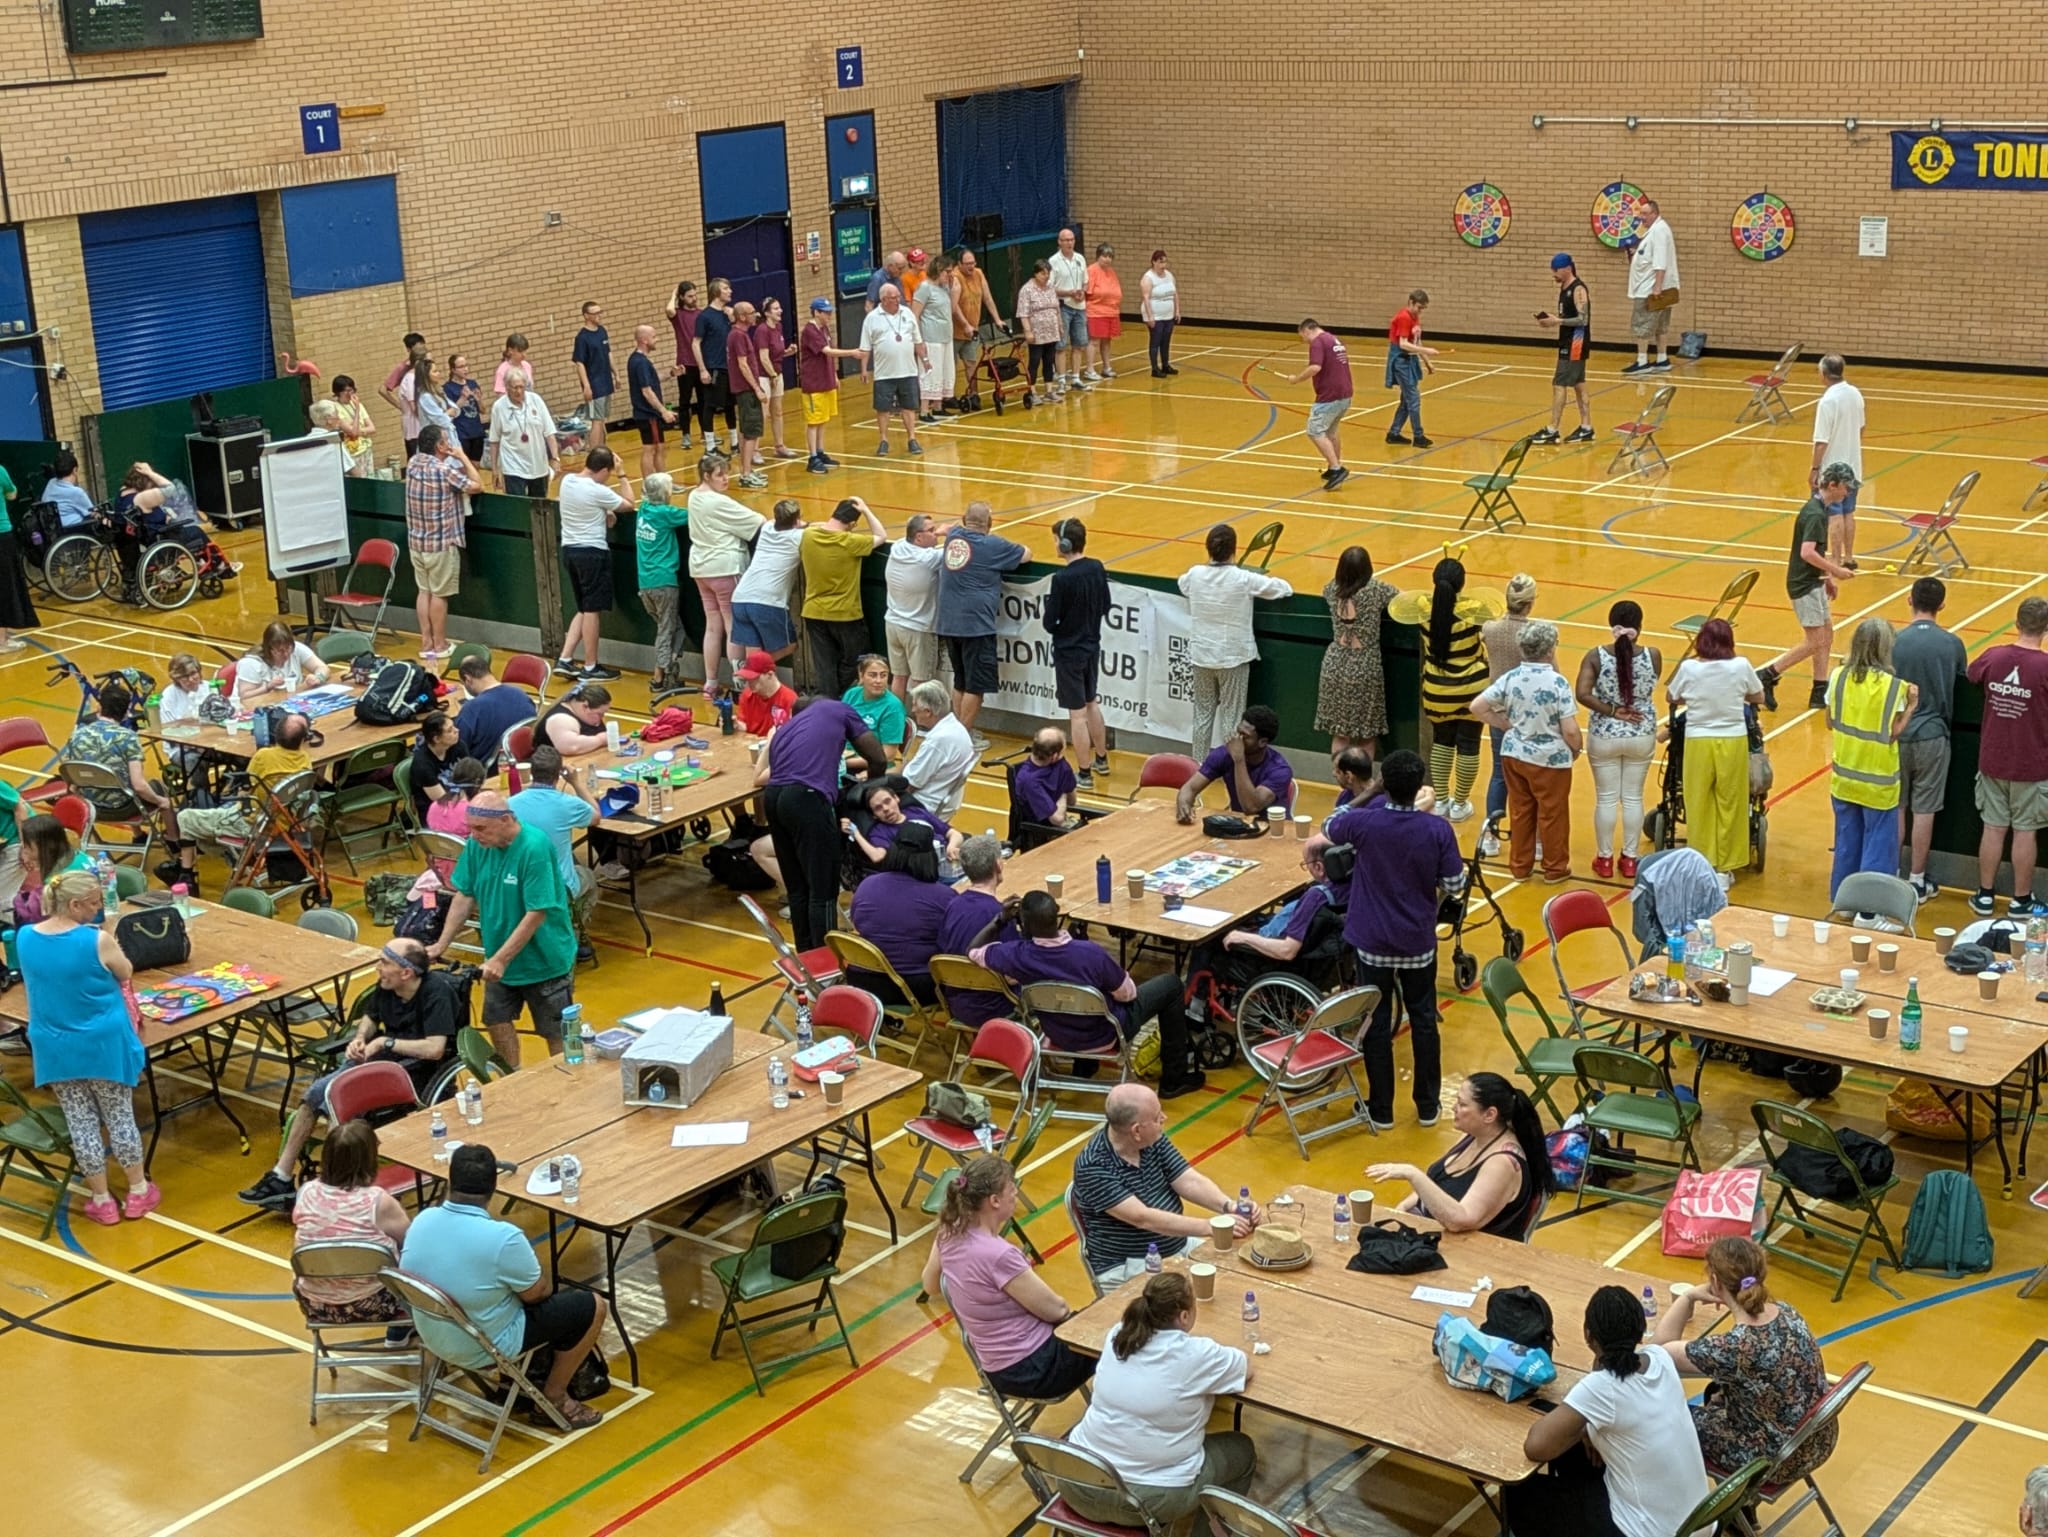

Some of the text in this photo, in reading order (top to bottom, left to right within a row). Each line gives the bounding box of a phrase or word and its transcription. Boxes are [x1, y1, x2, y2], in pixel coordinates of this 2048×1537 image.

[840, 51, 858, 60] COURT
[846, 64, 854, 80] 2
[305, 109, 332, 121] COURT
[316, 125, 325, 144] 1
[1988, 681, 2032, 699] aspens
